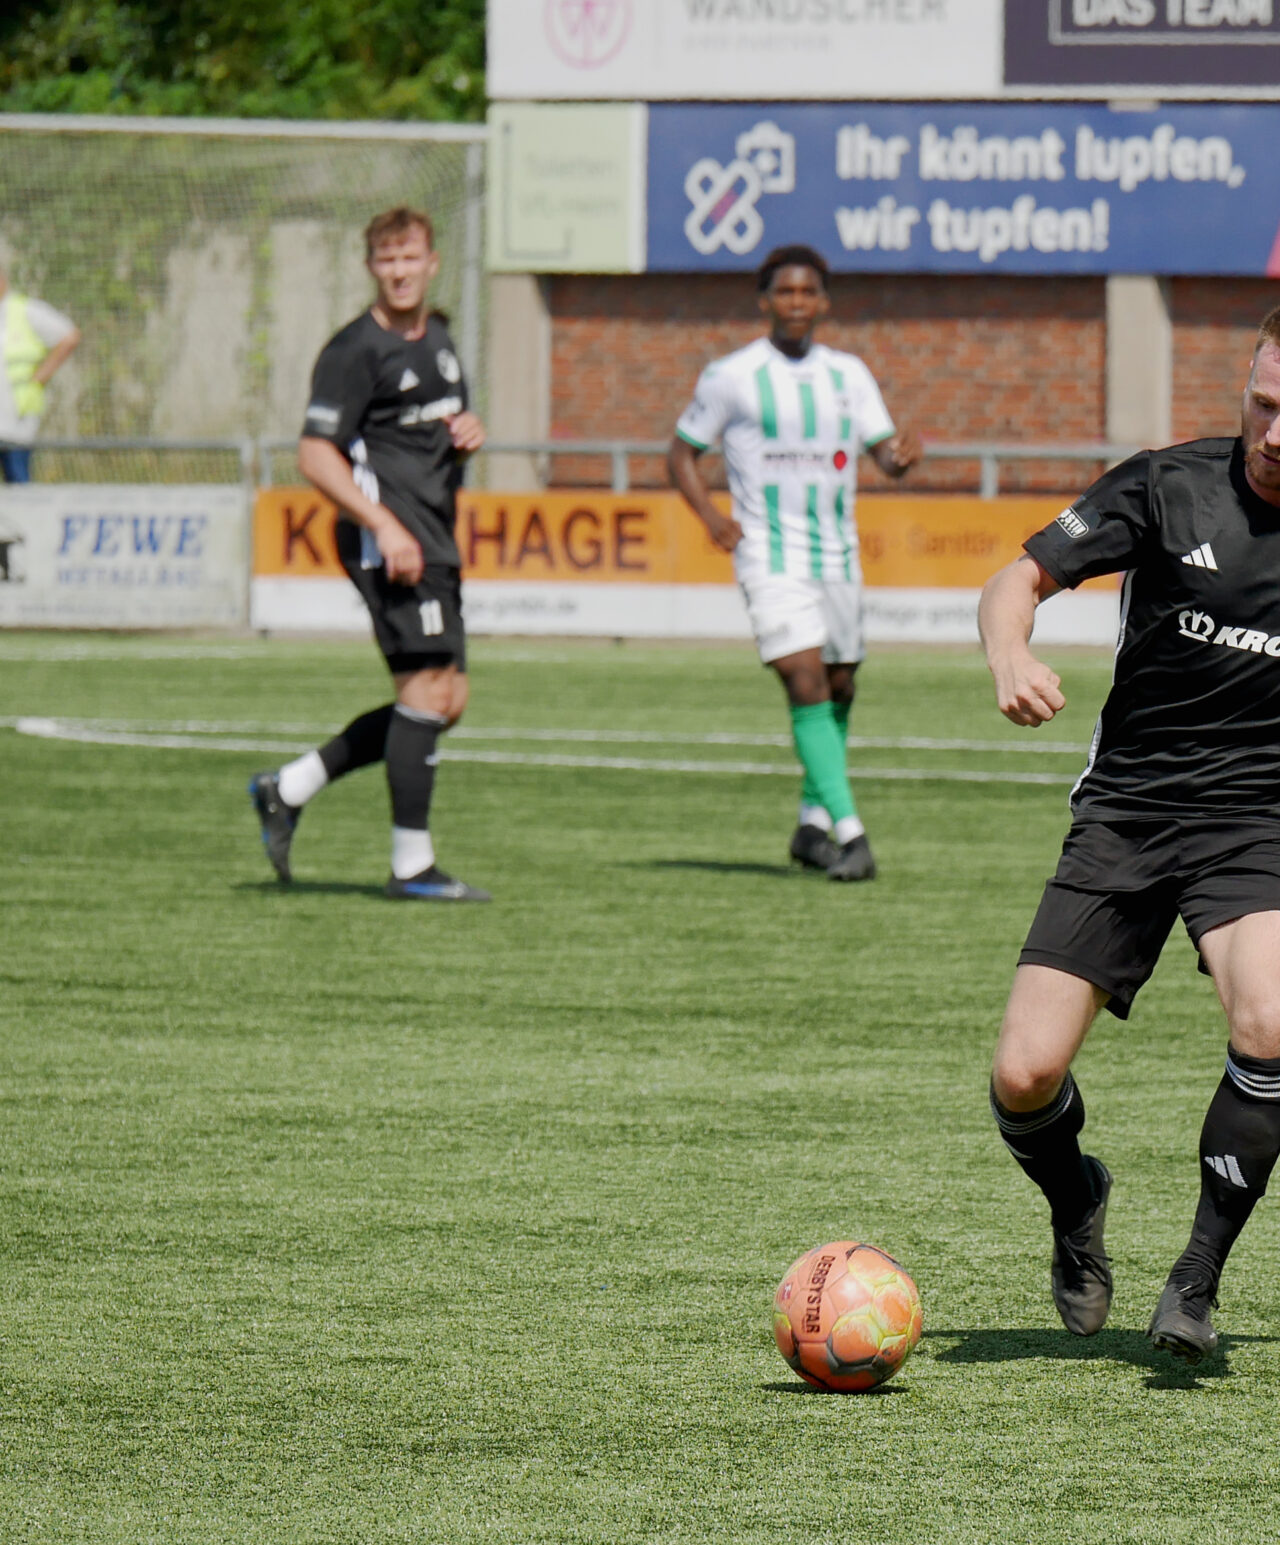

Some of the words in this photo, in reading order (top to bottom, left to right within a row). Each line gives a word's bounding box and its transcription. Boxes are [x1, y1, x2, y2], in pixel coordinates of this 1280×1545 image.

[1073, 0, 1153, 26] DAS
[1167, 0, 1273, 26] TEAM
[835, 123, 910, 181] Ihr
[918, 123, 1066, 181] könnt
[1074, 123, 1247, 193] lupfen,
[834, 195, 920, 251] wir
[927, 194, 1109, 263] tupfen!
[58, 513, 208, 556] FEWE
[281, 505, 649, 573] KHAGE
[418, 600, 444, 636] 11
[806, 1255, 837, 1334] DERBYSTAR
